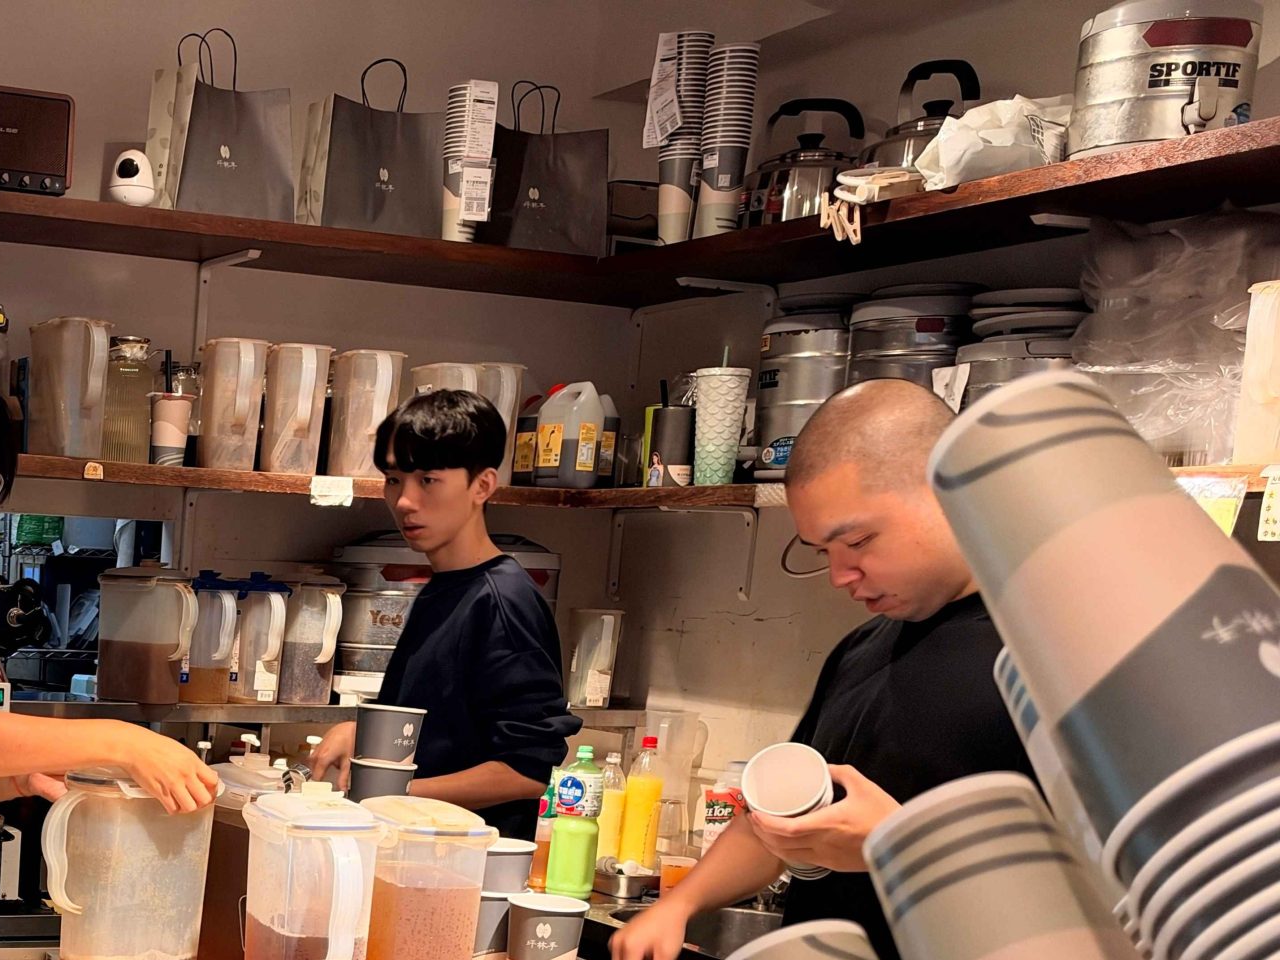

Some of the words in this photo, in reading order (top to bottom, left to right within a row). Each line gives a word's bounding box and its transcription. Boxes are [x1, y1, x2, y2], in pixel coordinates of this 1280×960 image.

[1148, 61, 1242, 78] SPORTIF
[526, 940, 558, 951] 坪林手
